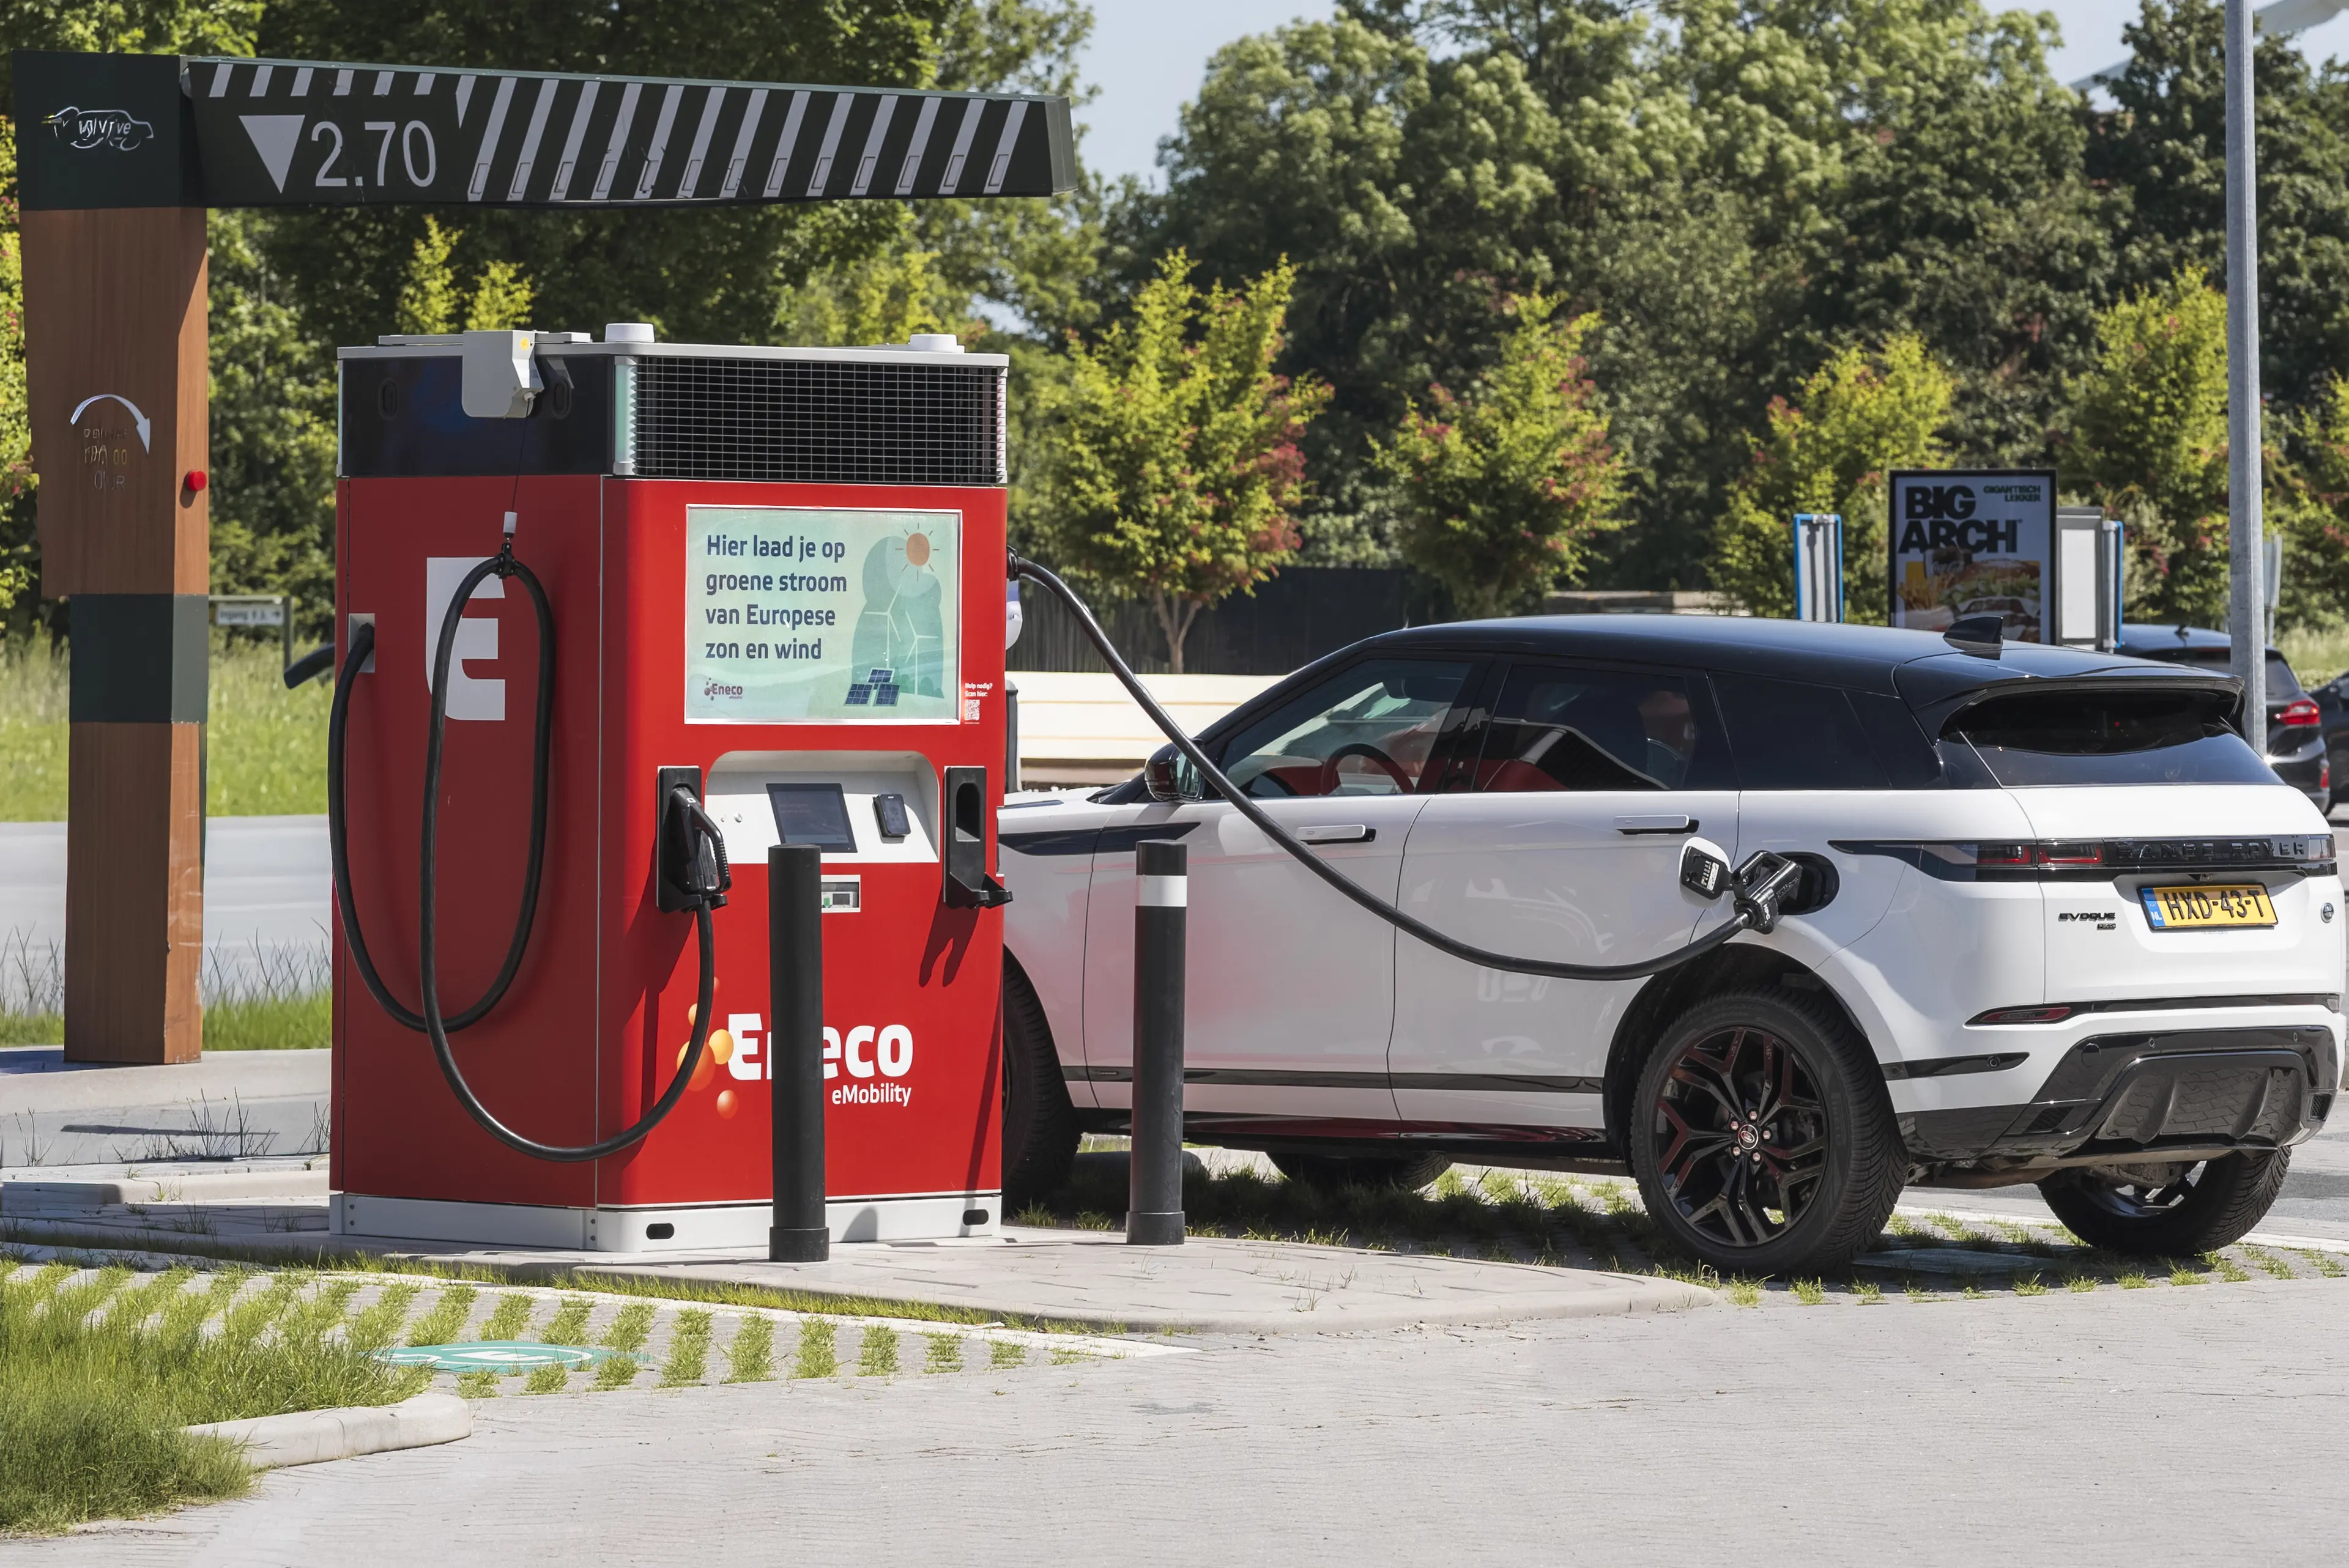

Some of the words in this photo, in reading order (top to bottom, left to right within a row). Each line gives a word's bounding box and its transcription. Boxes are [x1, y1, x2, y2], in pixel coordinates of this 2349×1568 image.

[311, 120, 436, 187] 2.70
[1905, 485, 1976, 519] BIG
[707, 534, 748, 557] Hier
[753, 534, 793, 557] laad
[799, 535, 816, 563] je
[822, 542, 845, 563] op
[1898, 519, 2018, 554] ARCH
[706, 574, 773, 596] groene
[779, 572, 847, 592] stroom
[705, 608, 740, 625] van
[746, 604, 836, 631] Europese
[705, 642, 740, 659] zon
[746, 643, 768, 659] en
[774, 637, 822, 660] wind
[711, 683, 743, 695] Eneco
[2058, 912, 2116, 922] EVOQUE
[2150, 911, 2162, 921] NL
[2163, 890, 2264, 920] HXD-43-T
[727, 1013, 913, 1081] Eeco
[832, 1082, 912, 1107] eMobility
